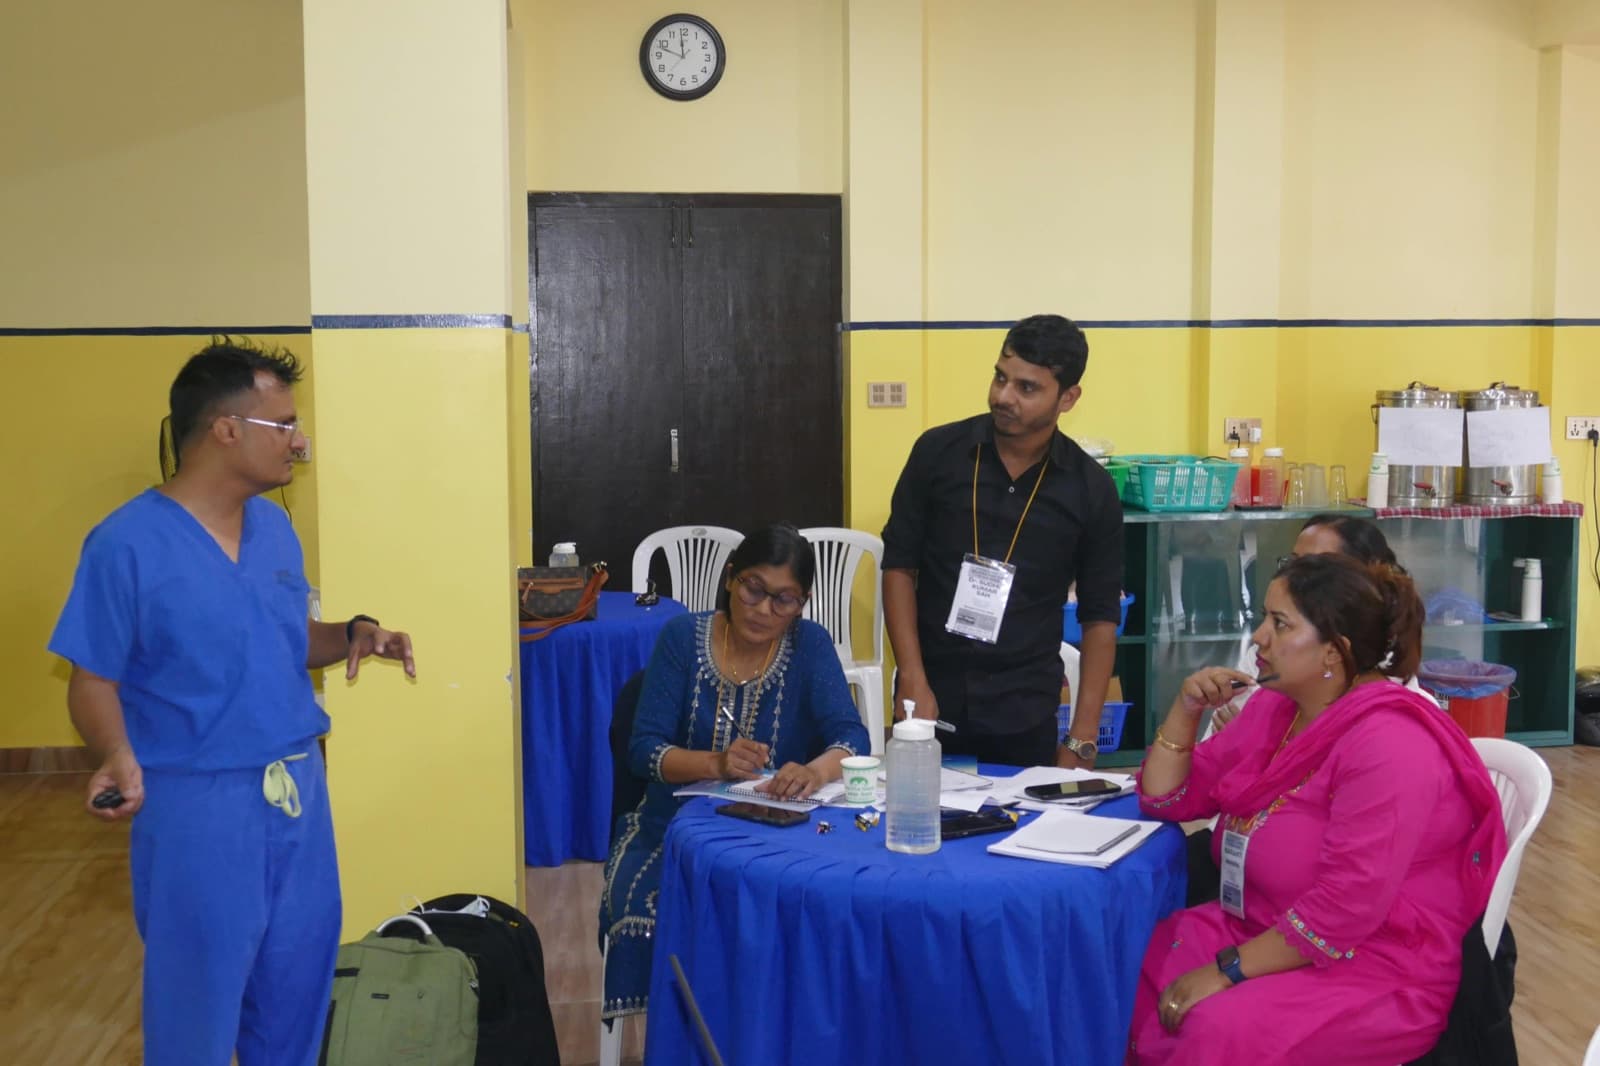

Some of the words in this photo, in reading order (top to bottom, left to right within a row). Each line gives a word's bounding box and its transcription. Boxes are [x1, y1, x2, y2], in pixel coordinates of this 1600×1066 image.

[680, 28, 689, 36] 12
[657, 40, 668, 48] 10
[702, 41, 708, 49] 2
[656, 51, 662, 59] 9
[705, 54, 711, 62] 3
[659, 64, 665, 72] 8
[680, 77, 687, 85] 6
[692, 75, 698, 83] 5
